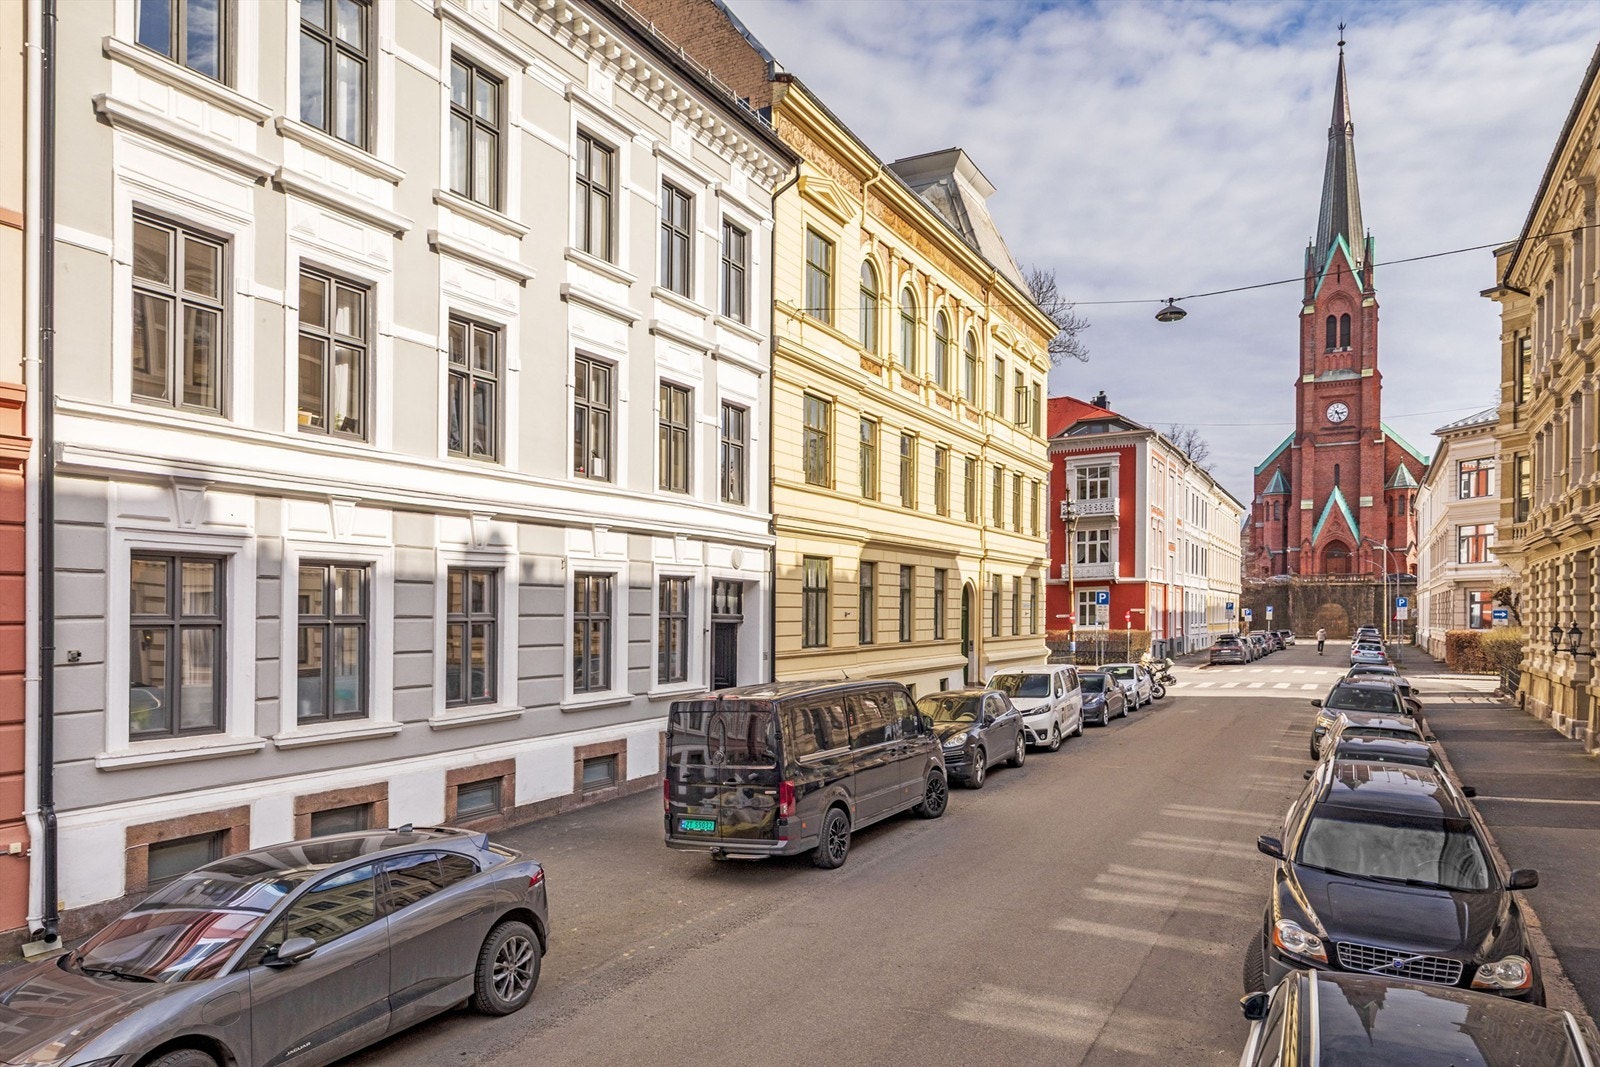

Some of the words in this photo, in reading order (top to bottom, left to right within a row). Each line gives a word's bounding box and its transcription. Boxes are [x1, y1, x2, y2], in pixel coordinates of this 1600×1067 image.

[1099, 593, 1106, 603] P
[1398, 598, 1405, 606] P
[285, 1041, 311, 1056] JAGUAR
